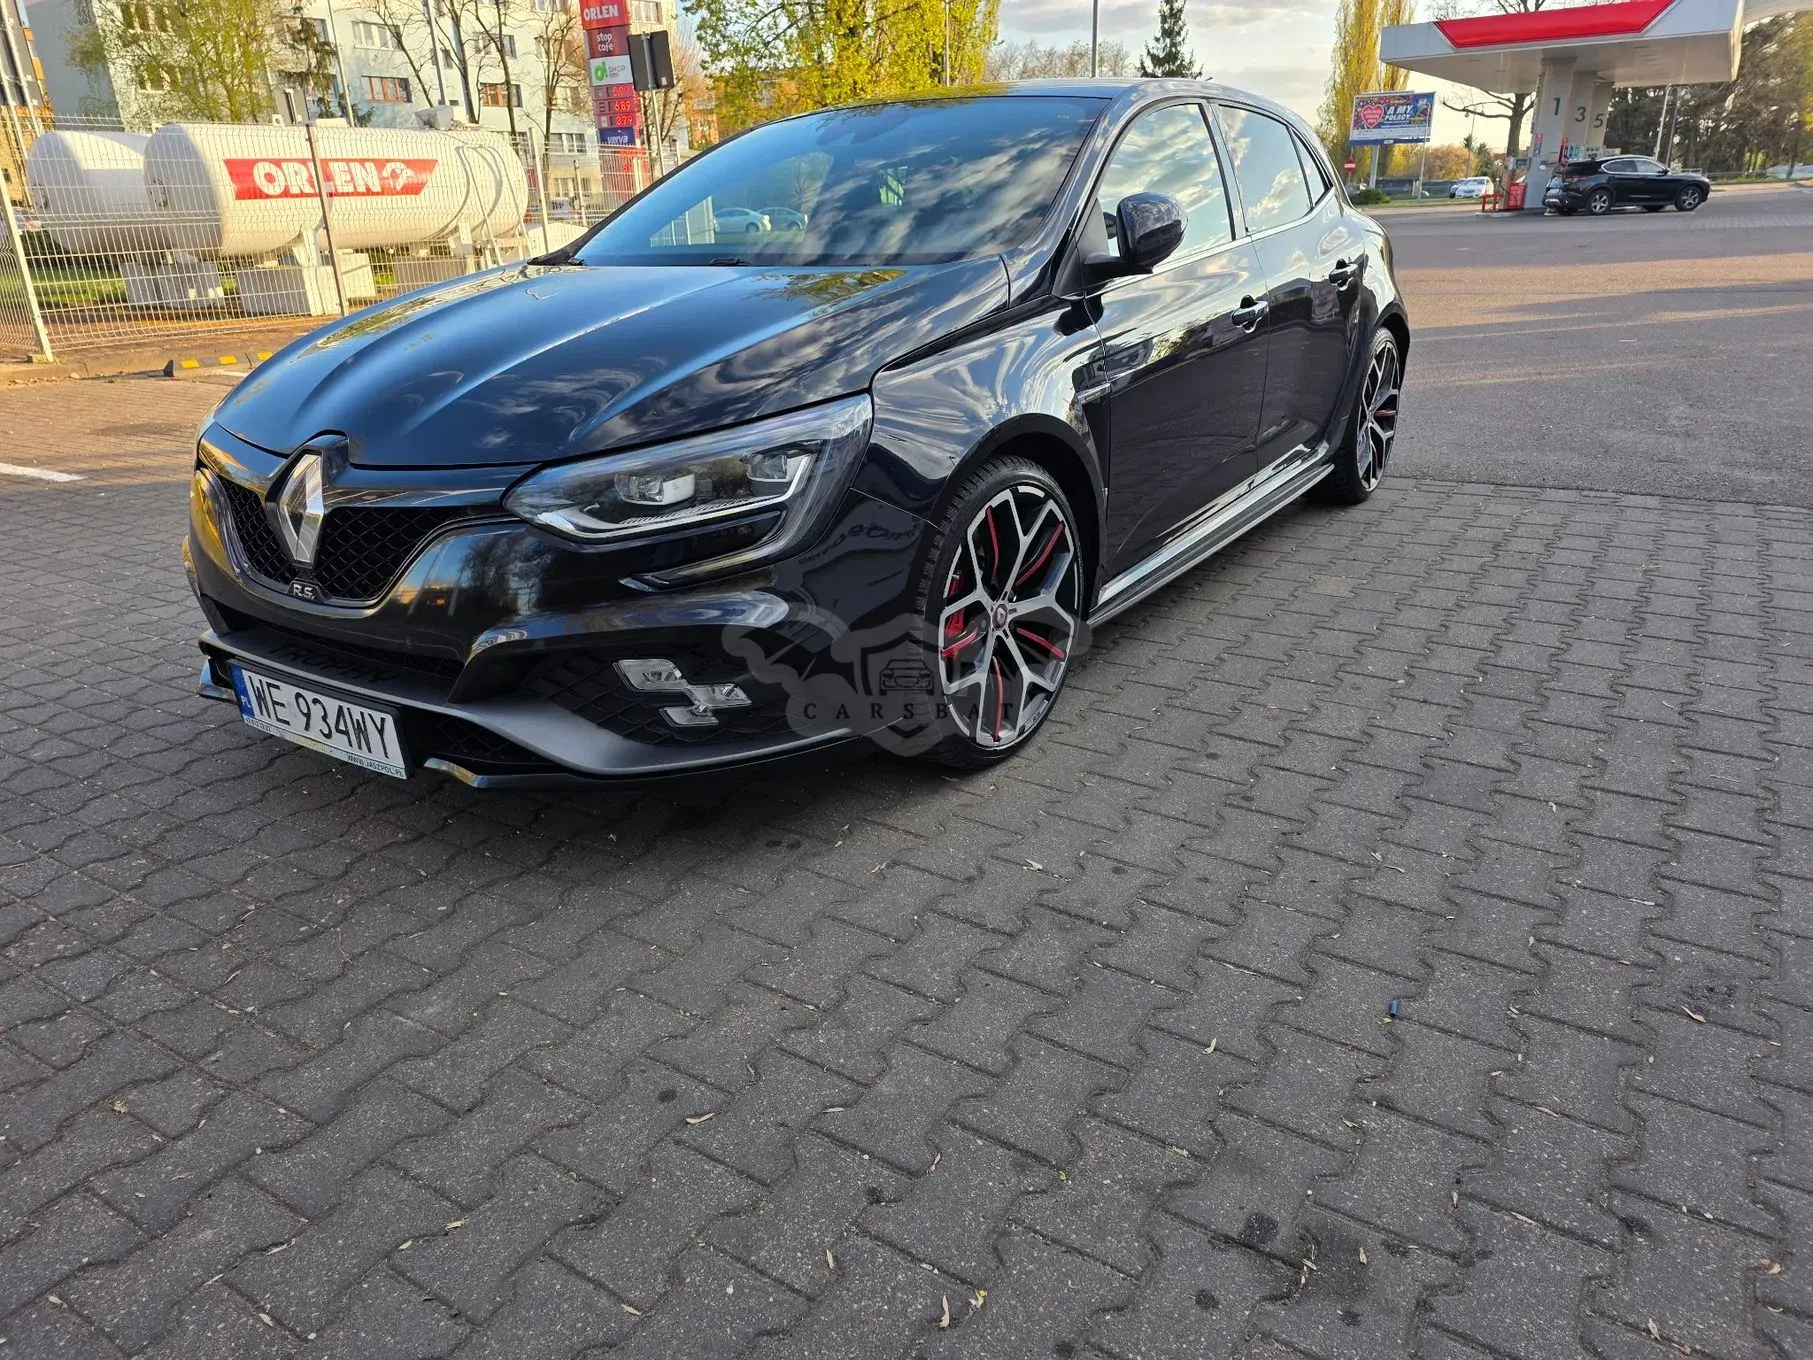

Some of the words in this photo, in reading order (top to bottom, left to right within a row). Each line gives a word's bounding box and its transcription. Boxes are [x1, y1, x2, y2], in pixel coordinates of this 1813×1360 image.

[584, 4, 619, 21] ORLEN
[596, 32, 613, 43] stop
[598, 43, 614, 53] cafe
[1553, 97, 1561, 116] 1
[1575, 106, 1587, 123] 3
[1593, 113, 1605, 128] 5
[240, 695, 252, 709] PL
[248, 675, 291, 727] WE
[294, 690, 390, 760] 934WY
